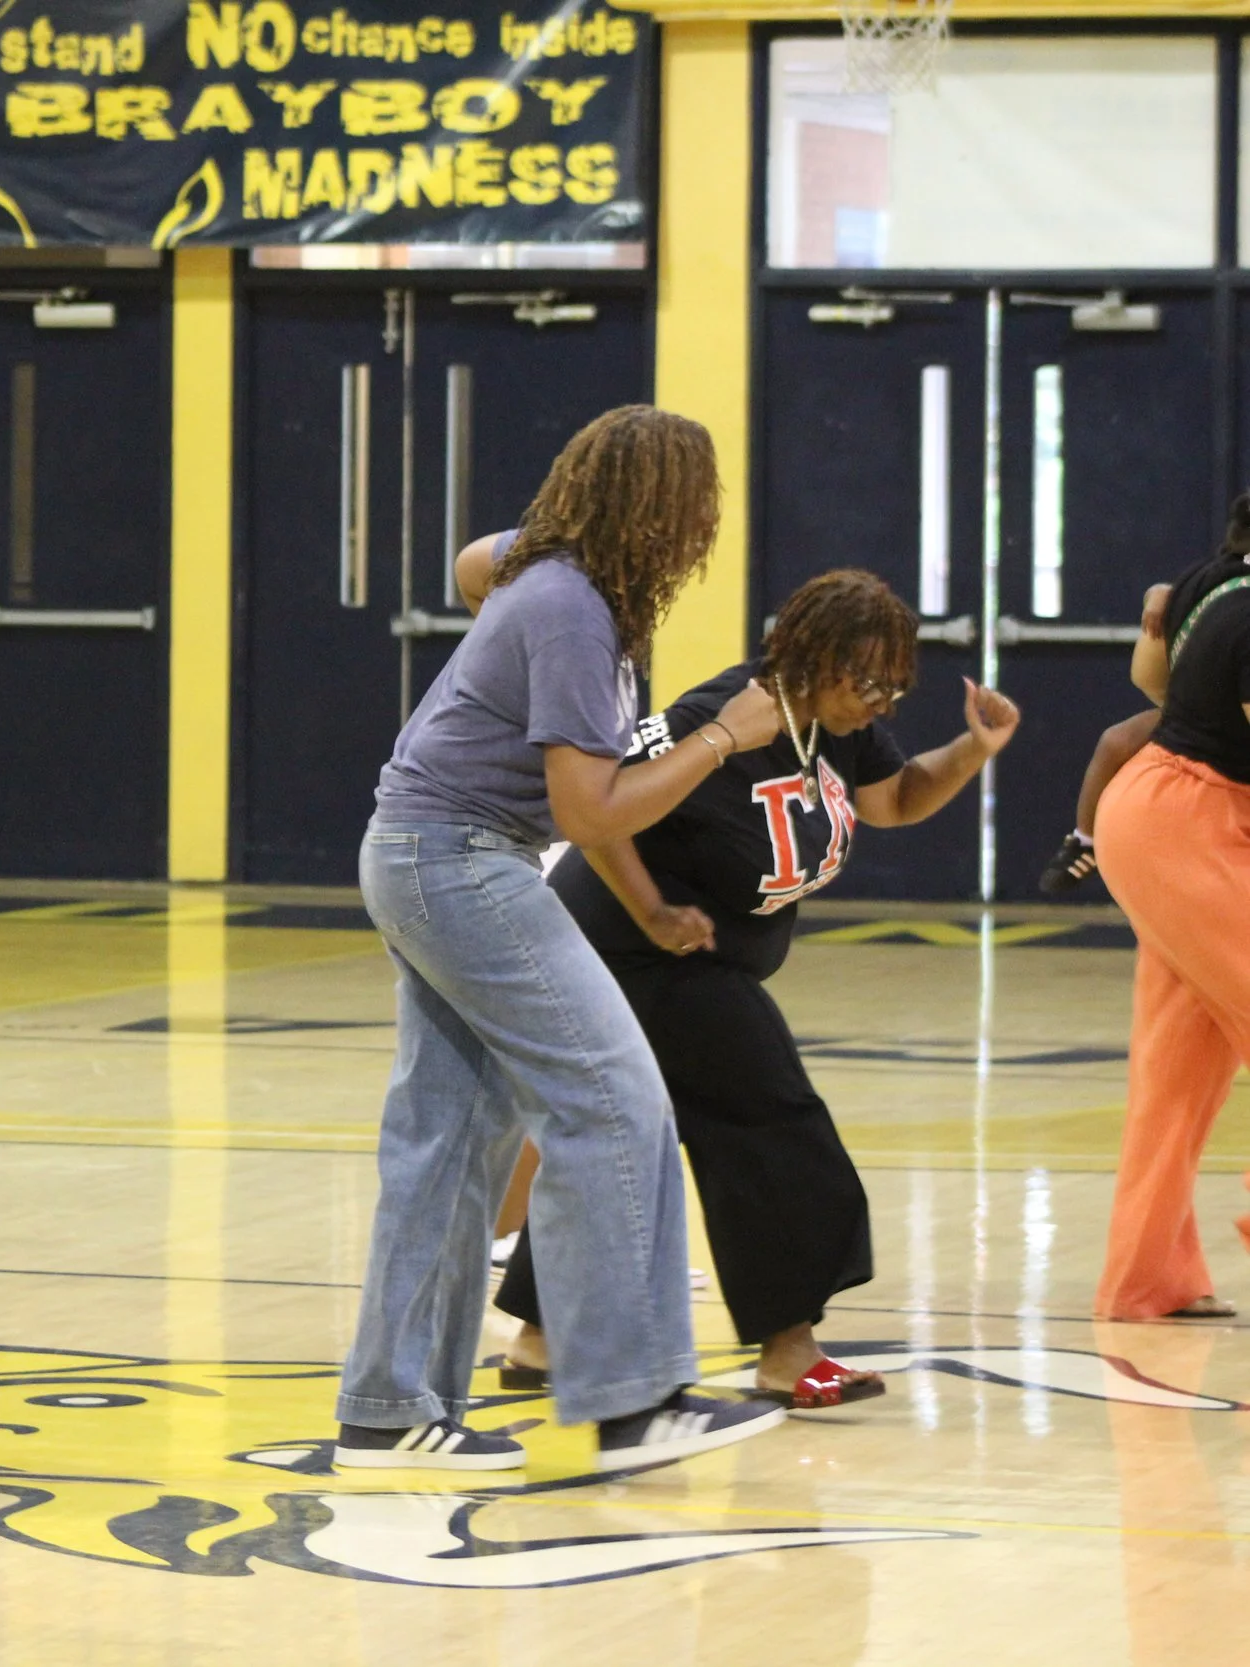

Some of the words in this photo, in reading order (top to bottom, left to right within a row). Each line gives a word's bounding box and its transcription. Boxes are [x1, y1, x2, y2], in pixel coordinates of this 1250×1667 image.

[0, 17, 144, 76] stand
[186, 1, 295, 72] NO
[302, 10, 474, 62] chance
[500, 12, 636, 60] inside
[5, 79, 607, 141] BRAYBOY
[243, 142, 618, 219] MADNESS
